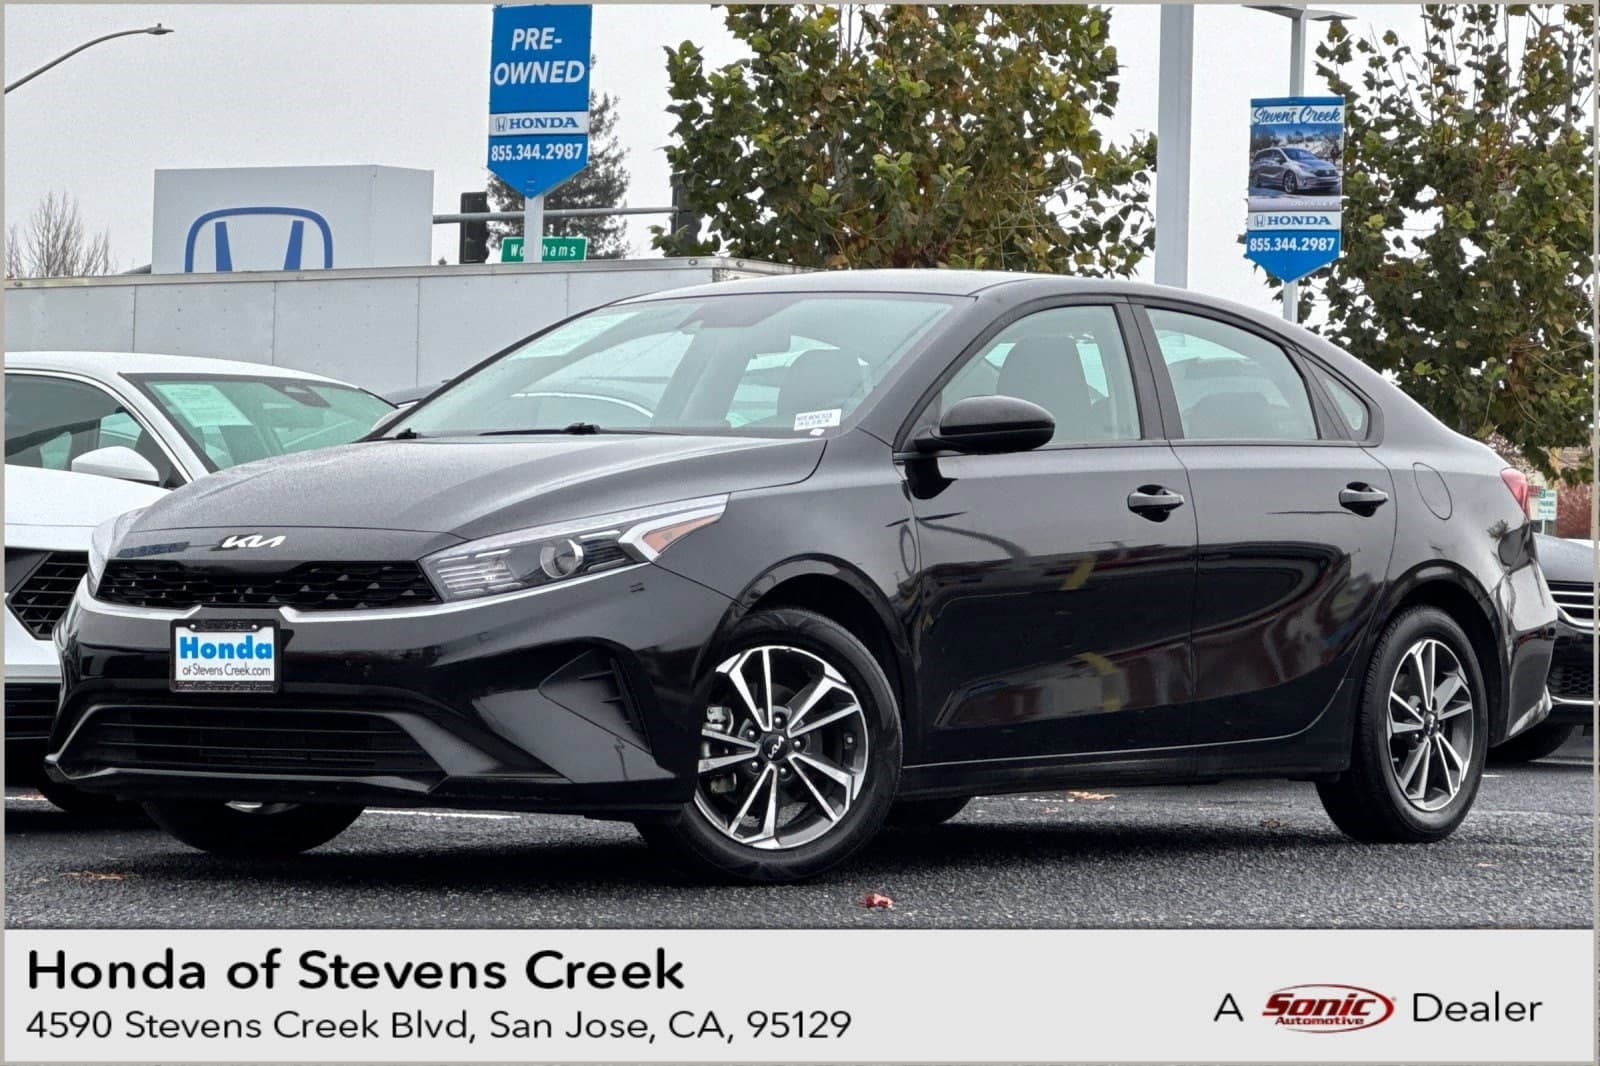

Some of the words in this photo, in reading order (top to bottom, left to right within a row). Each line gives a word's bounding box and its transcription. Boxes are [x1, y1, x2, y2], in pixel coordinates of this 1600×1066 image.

[511, 27, 563, 51] PRE-
[493, 60, 585, 86] OWNED
[508, 117, 579, 129] HONDA
[1254, 108, 1295, 123] Stevens
[1300, 106, 1340, 123] Creek
[491, 143, 583, 161] 855.344.2987
[1267, 215, 1331, 226] HONDA
[511, 243, 577, 257] Wohams
[1249, 237, 1336, 252] 855.344.2987
[180, 635, 272, 659] Honda
